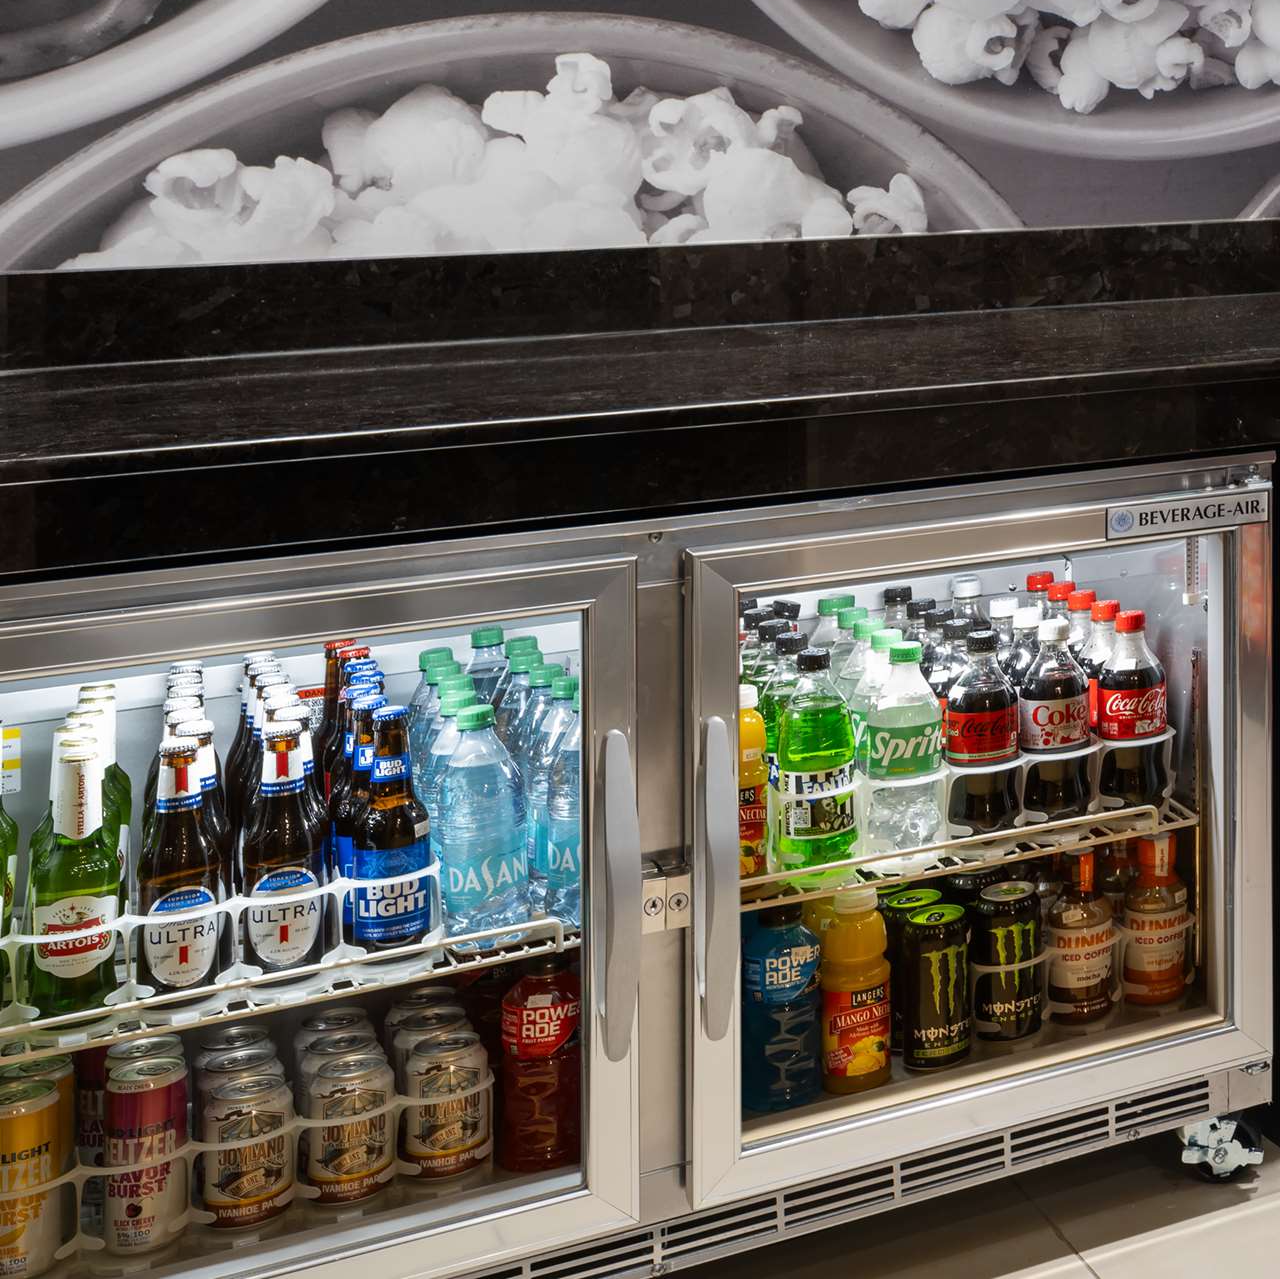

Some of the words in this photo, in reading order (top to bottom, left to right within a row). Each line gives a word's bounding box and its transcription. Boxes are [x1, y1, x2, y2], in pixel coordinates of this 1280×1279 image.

[1138, 497, 1262, 528] BEVERAGE-AIR
[1032, 701, 1086, 727] Coke
[375, 765, 406, 777] LIGHT
[379, 759, 401, 769] BUD
[359, 890, 427, 917] LIGHT
[251, 903, 318, 924] ULTRA
[150, 921, 215, 945] ULTRA
[1135, 936, 1154, 945] ICED
[47, 935, 100, 951] ARTOIS
[1062, 952, 1081, 962] ICED
[1084, 947, 1112, 960] COFFEE
[766, 968, 800, 985] ADE
[1077, 973, 1101, 982] mocha
[852, 986, 885, 1006] LANGERS
[835, 1011, 870, 1029] MANGO
[522, 1022, 560, 1038] ADE
[419, 1156, 456, 1168] IVANHOE
[108, 1178, 167, 1198] BURST
